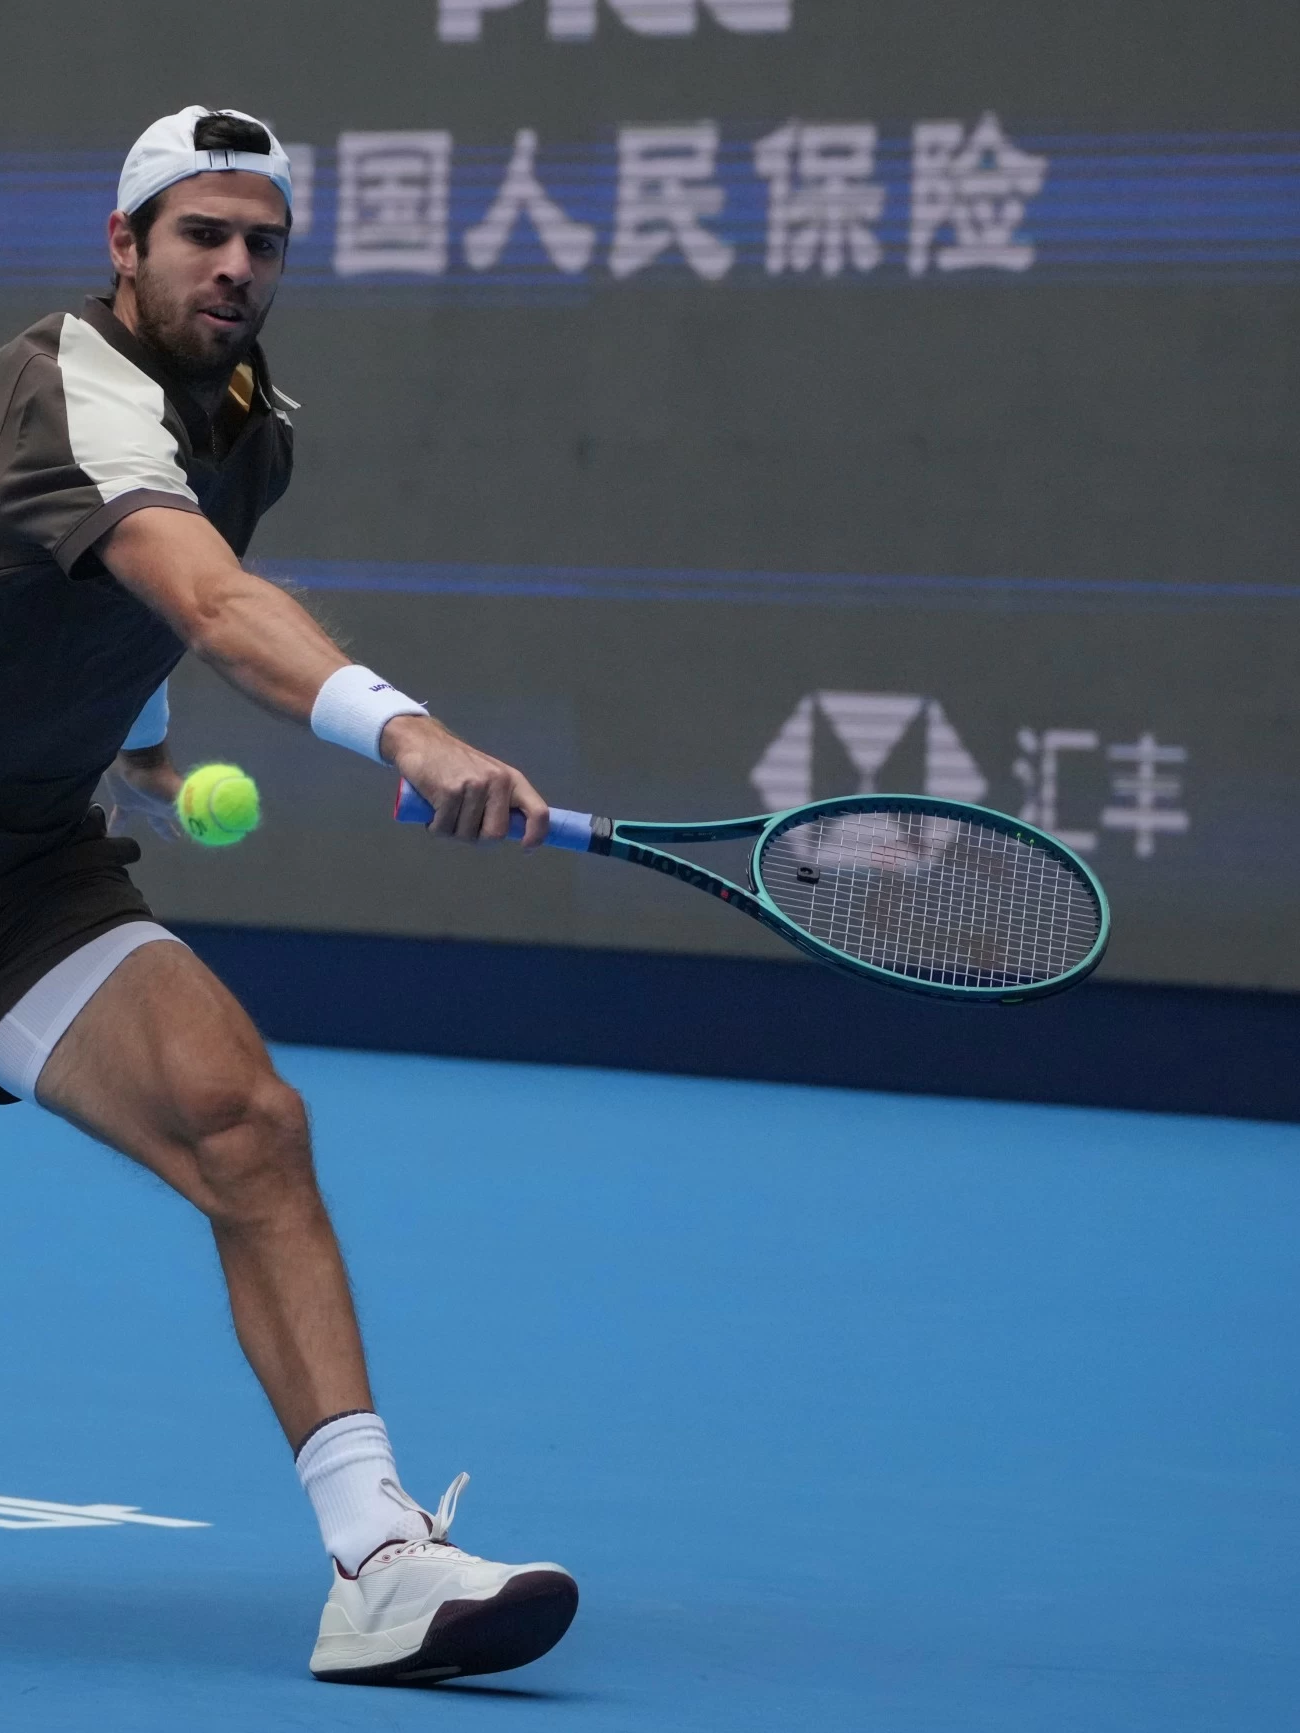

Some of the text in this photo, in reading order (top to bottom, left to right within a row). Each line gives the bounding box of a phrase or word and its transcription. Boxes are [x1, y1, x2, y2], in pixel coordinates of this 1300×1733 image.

[282, 110, 1049, 280] 国人民保险
[1013, 727, 1190, 858] 汇丰
